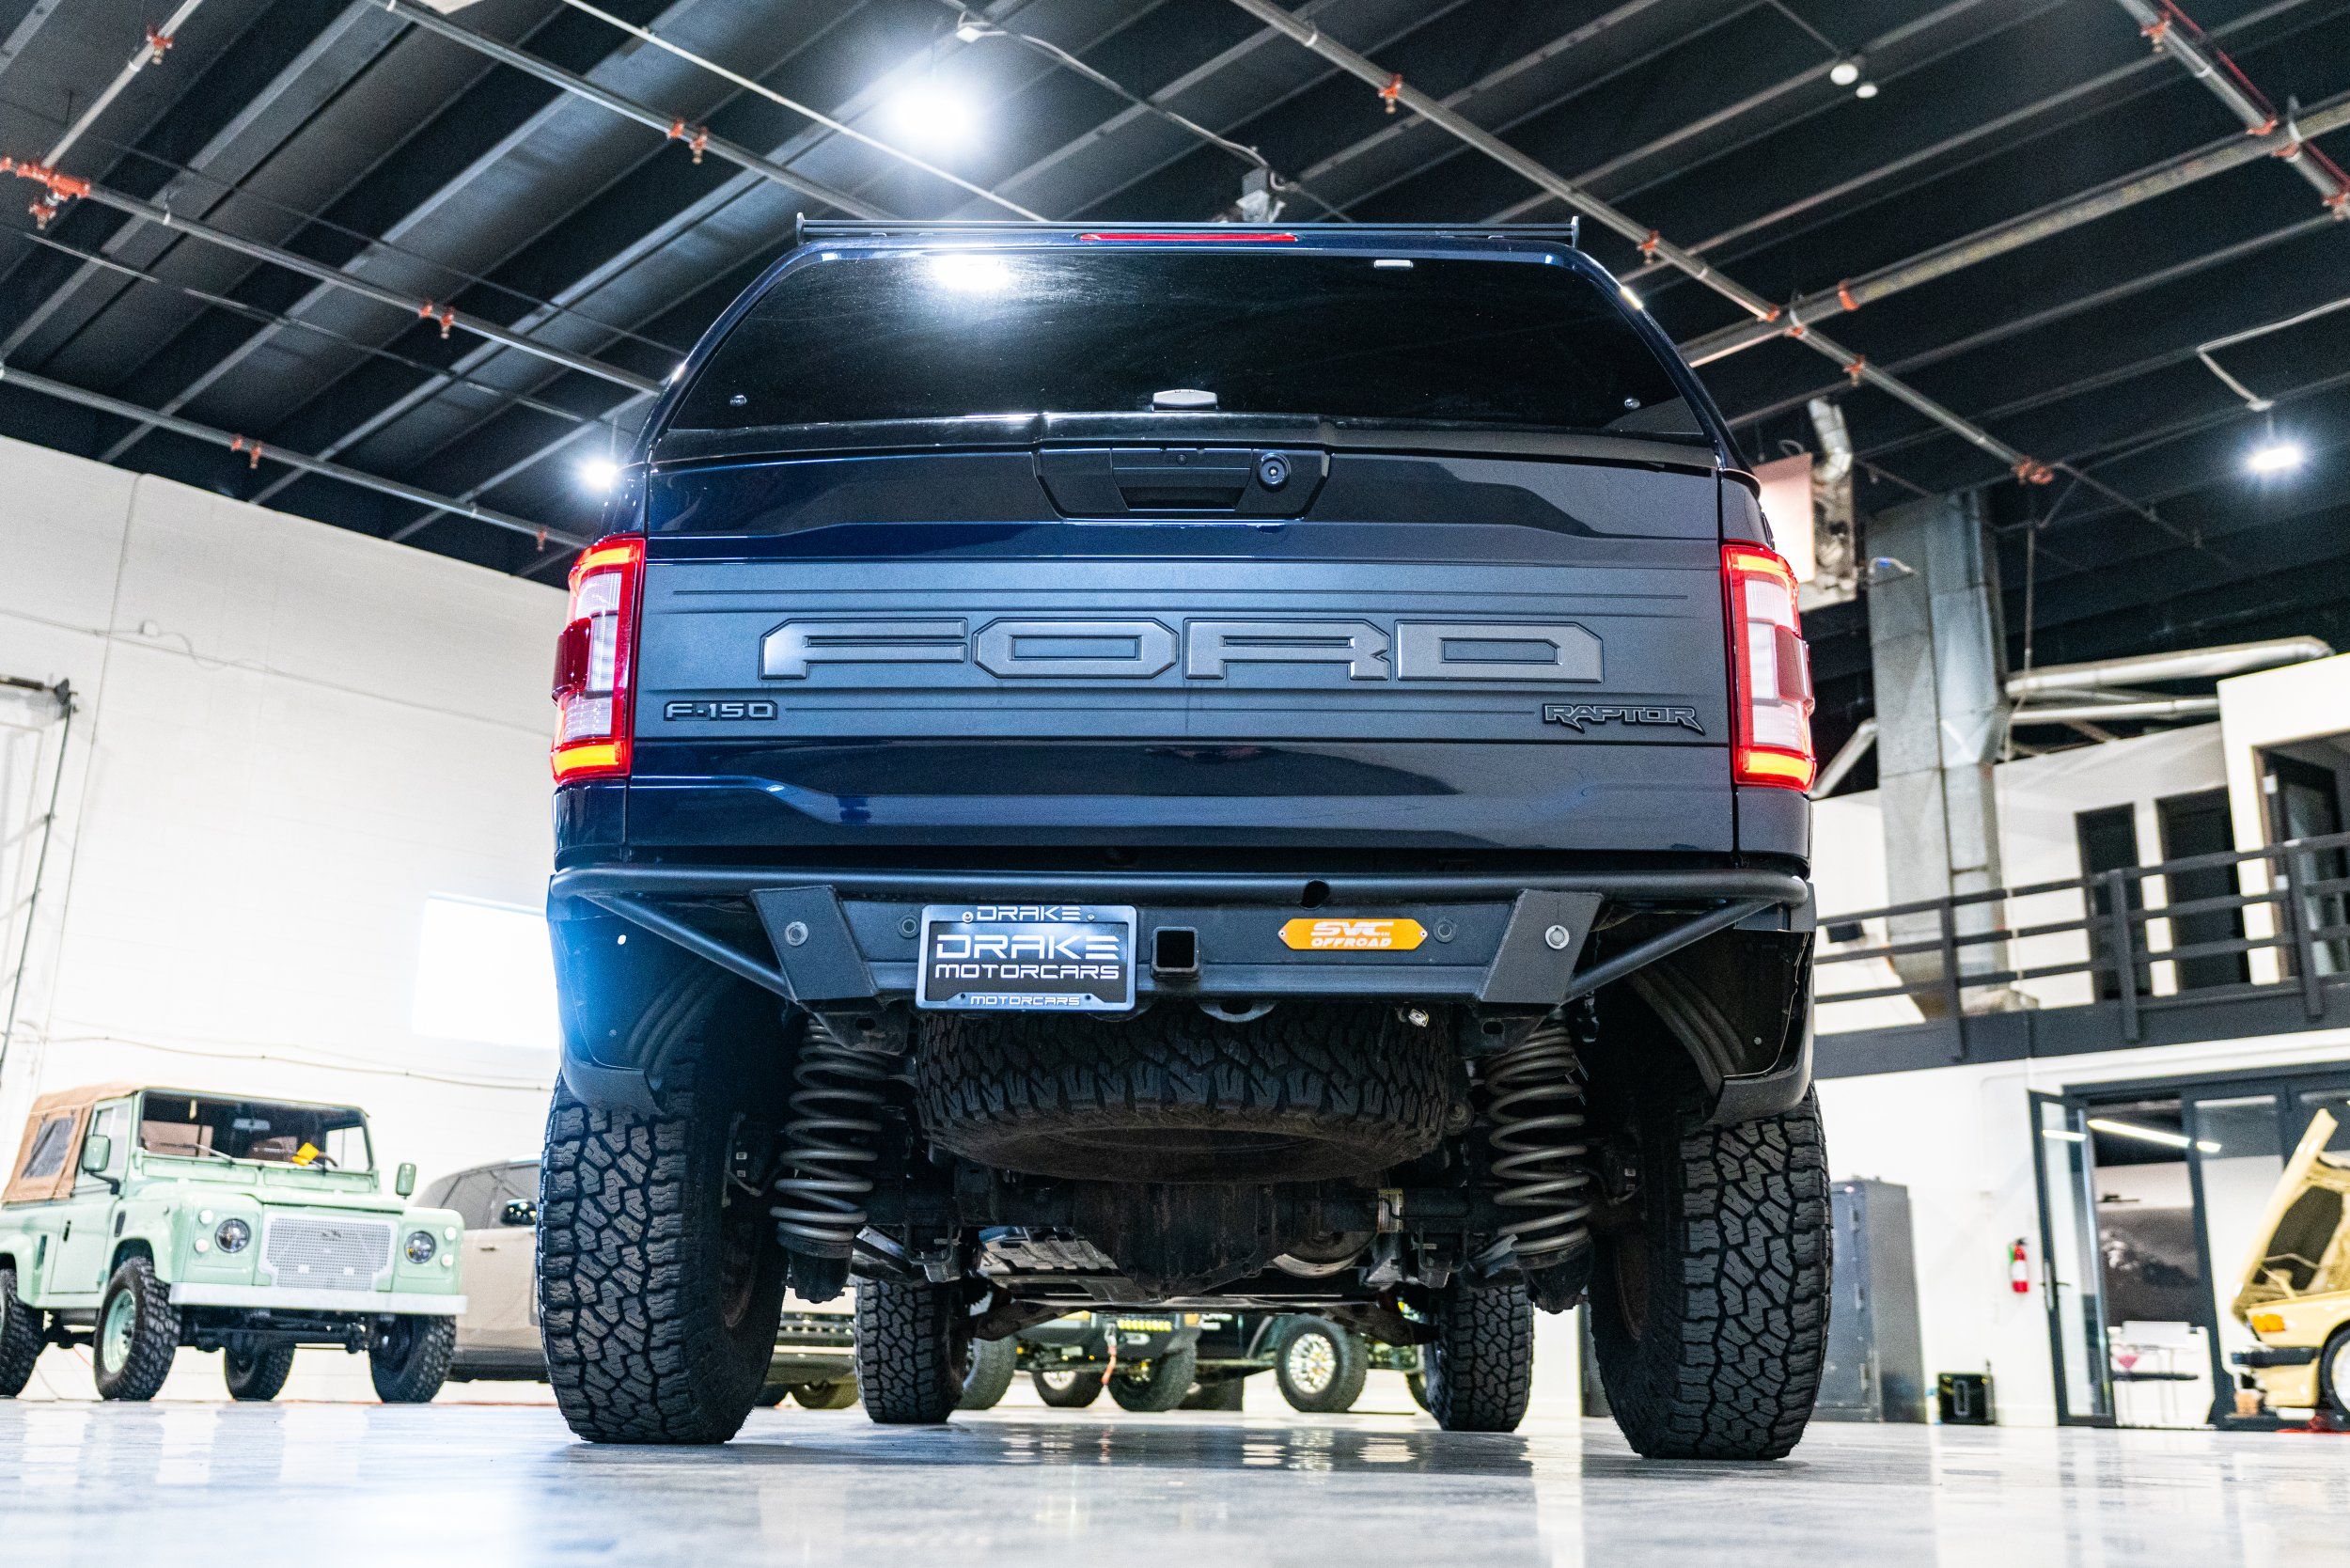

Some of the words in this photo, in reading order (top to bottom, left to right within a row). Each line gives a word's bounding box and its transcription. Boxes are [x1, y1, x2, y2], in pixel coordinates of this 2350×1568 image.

[758, 618, 1603, 684] FORD
[666, 702, 774, 718] F-150
[1543, 705, 1704, 734] RAPTOR
[976, 905, 1081, 921] DRAKE
[1310, 921, 1394, 936] SVC
[935, 934, 1120, 960] DRAKE
[1310, 937, 1392, 948] OFFROAD
[934, 964, 1120, 980] MOTORCARS
[970, 996, 1080, 1006] MOTORCARS
